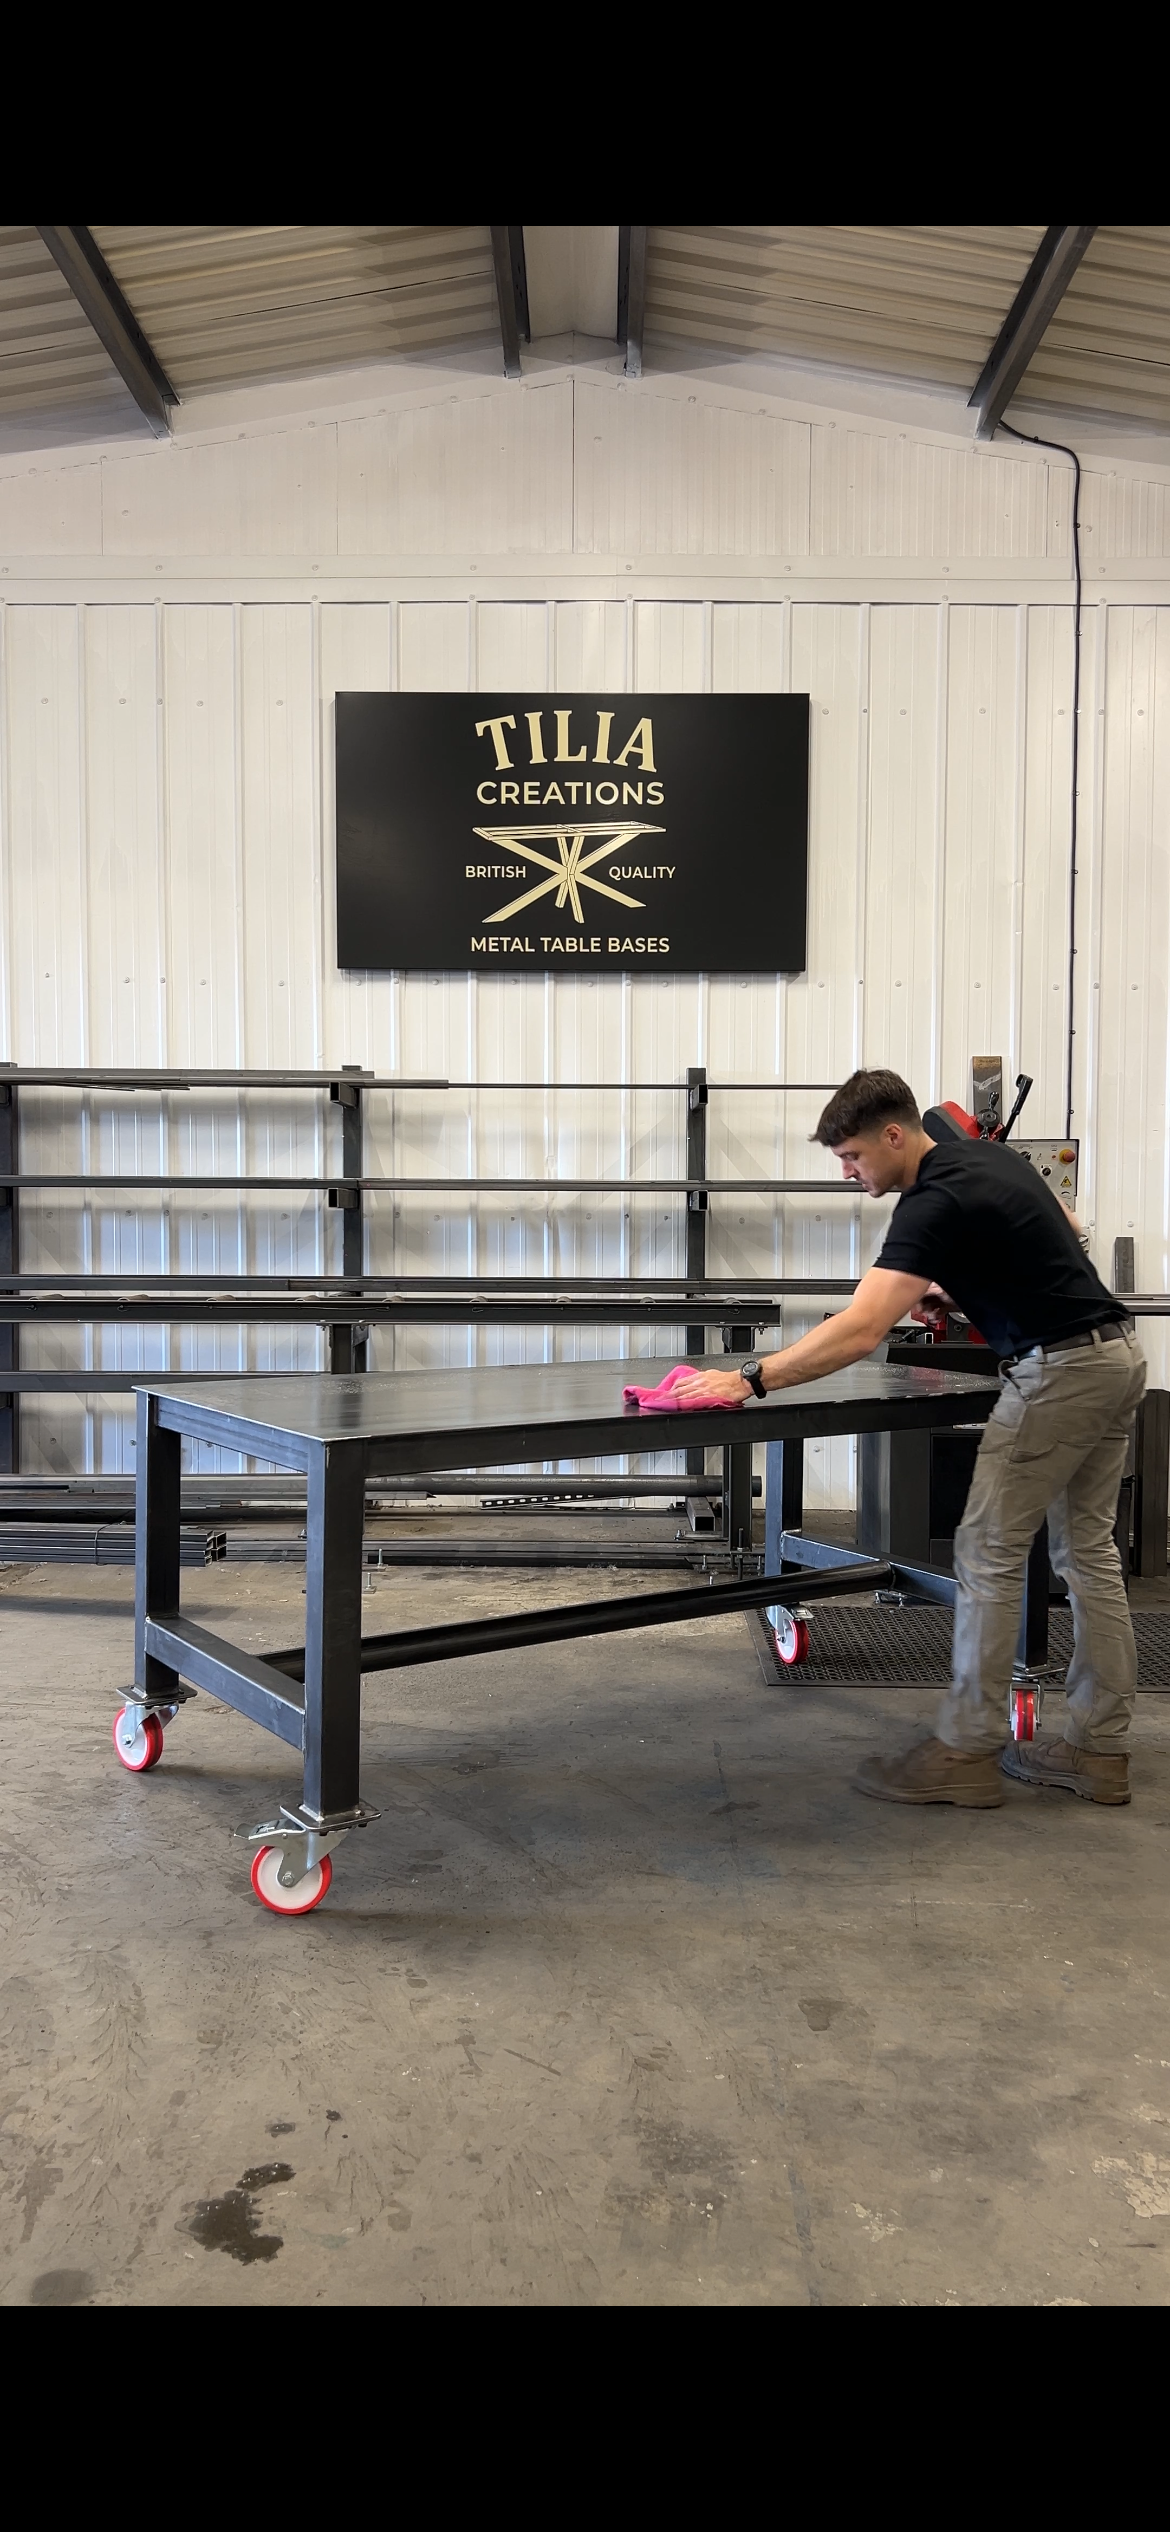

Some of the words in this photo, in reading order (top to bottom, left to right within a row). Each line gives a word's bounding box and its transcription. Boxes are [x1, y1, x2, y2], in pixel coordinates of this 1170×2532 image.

[474, 709, 658, 773] TILIA
[476, 781, 665, 806] CREATIONS
[465, 865, 526, 879] BRITISH
[608, 865, 676, 881] QUALITY
[470, 936, 535, 953] METAL
[539, 936, 602, 953] TABLE
[607, 937, 670, 953] BASES
